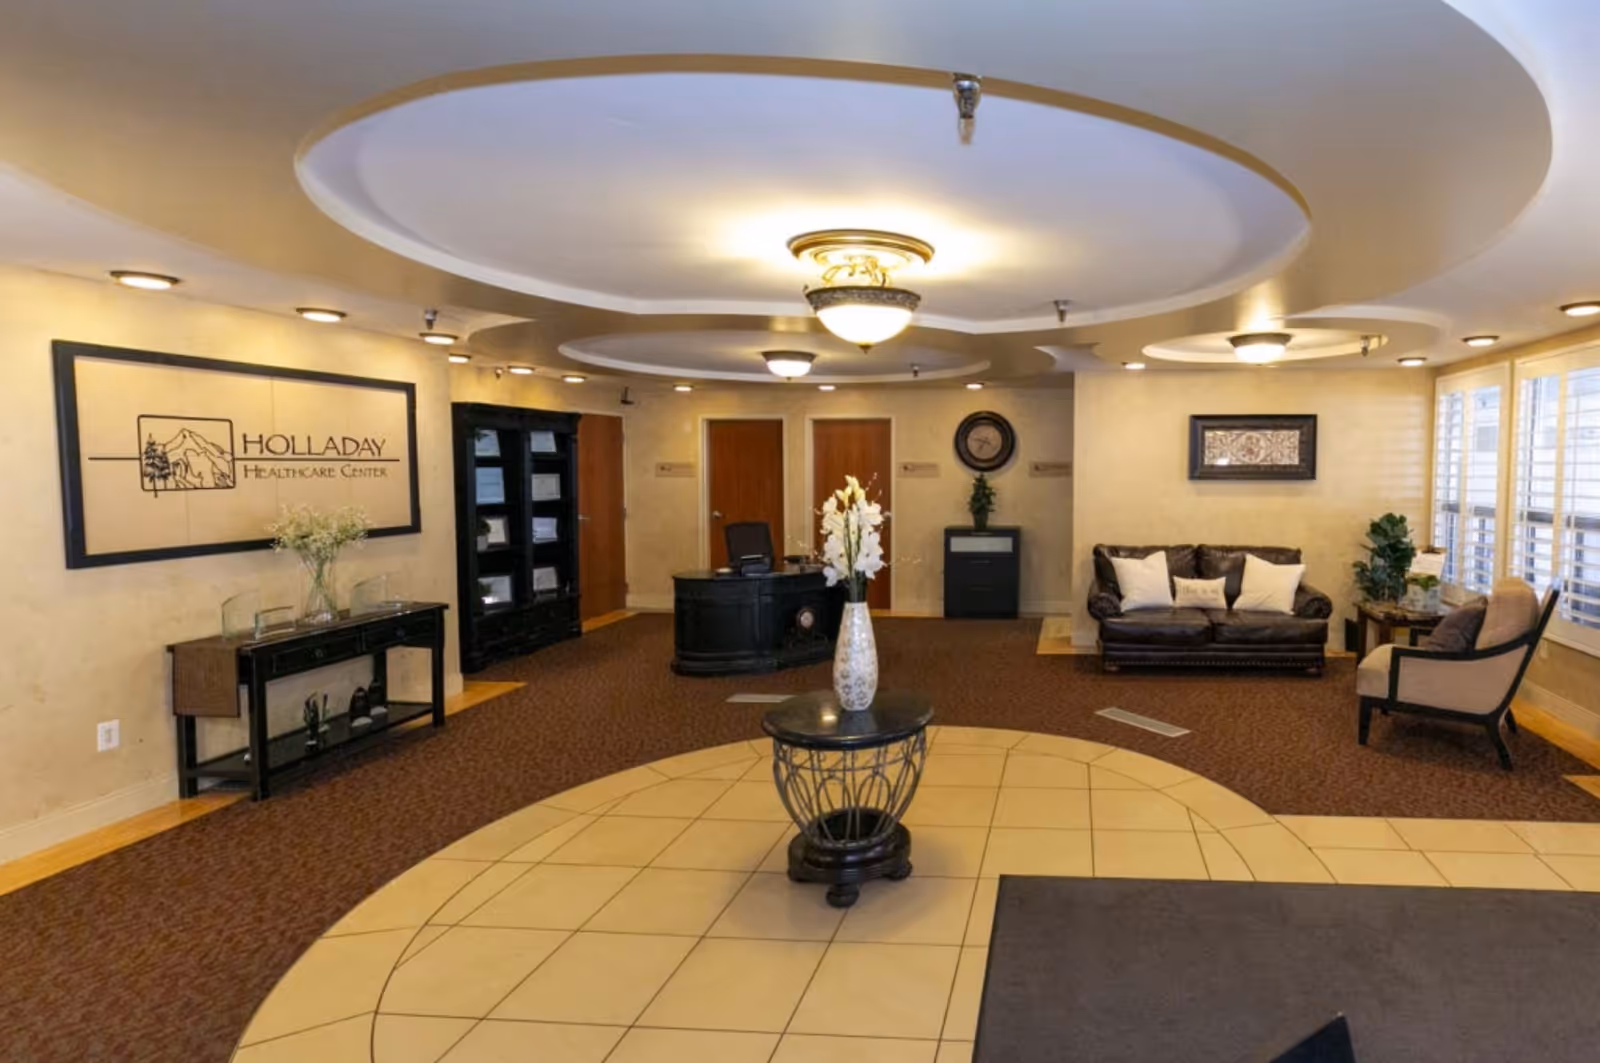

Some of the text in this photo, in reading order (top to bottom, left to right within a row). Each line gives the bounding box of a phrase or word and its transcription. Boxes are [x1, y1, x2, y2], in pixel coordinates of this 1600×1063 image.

[242, 433, 386, 457] HOLLADAY
[243, 464, 388, 479] HEALTHCARE CENTER
